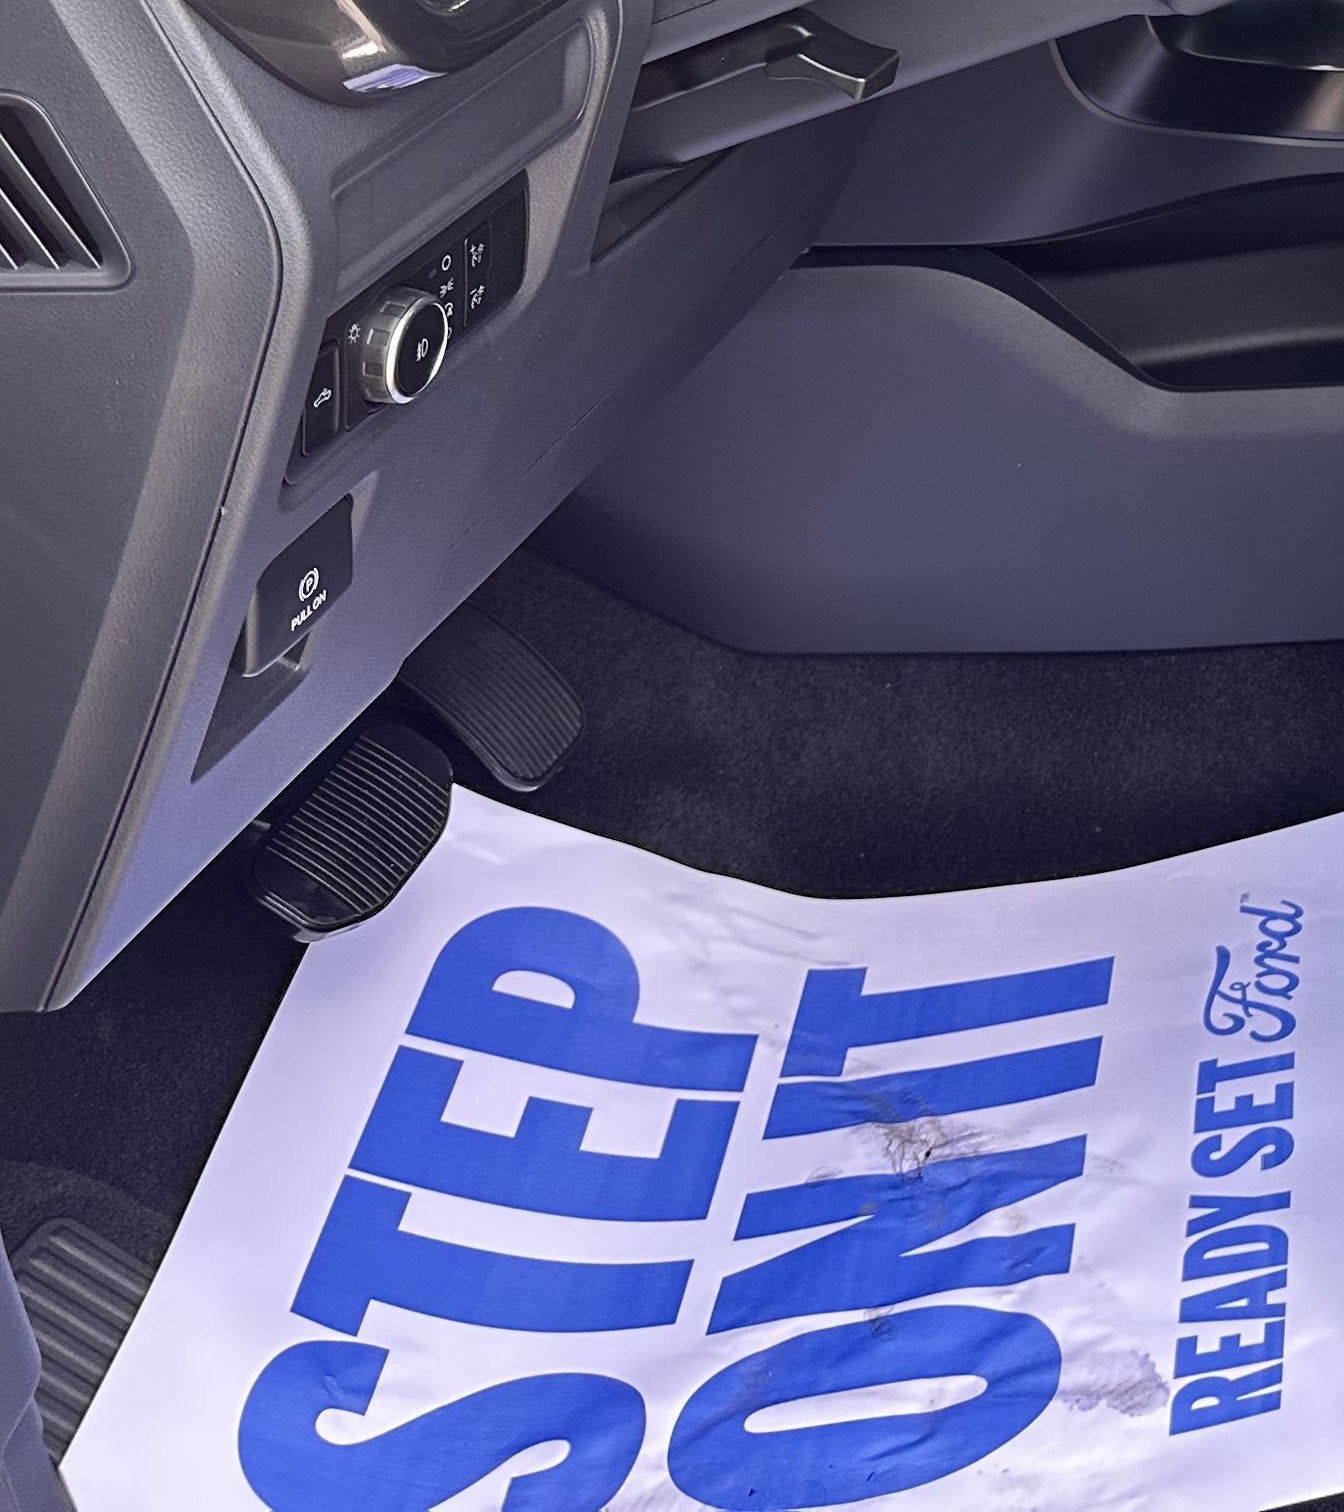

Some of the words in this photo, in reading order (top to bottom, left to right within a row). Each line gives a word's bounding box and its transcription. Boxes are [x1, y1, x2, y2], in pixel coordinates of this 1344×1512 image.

[291, 605, 313, 631] PULL
[313, 589, 327, 610] ON
[763, 956, 1114, 1141] IT
[1203, 899, 1304, 1043] Ford
[1190, 1051, 1296, 1179] SET
[237, 906, 758, 1512] STEP
[667, 1134, 1088, 1512] ON
[1170, 1191, 1292, 1435] READY
